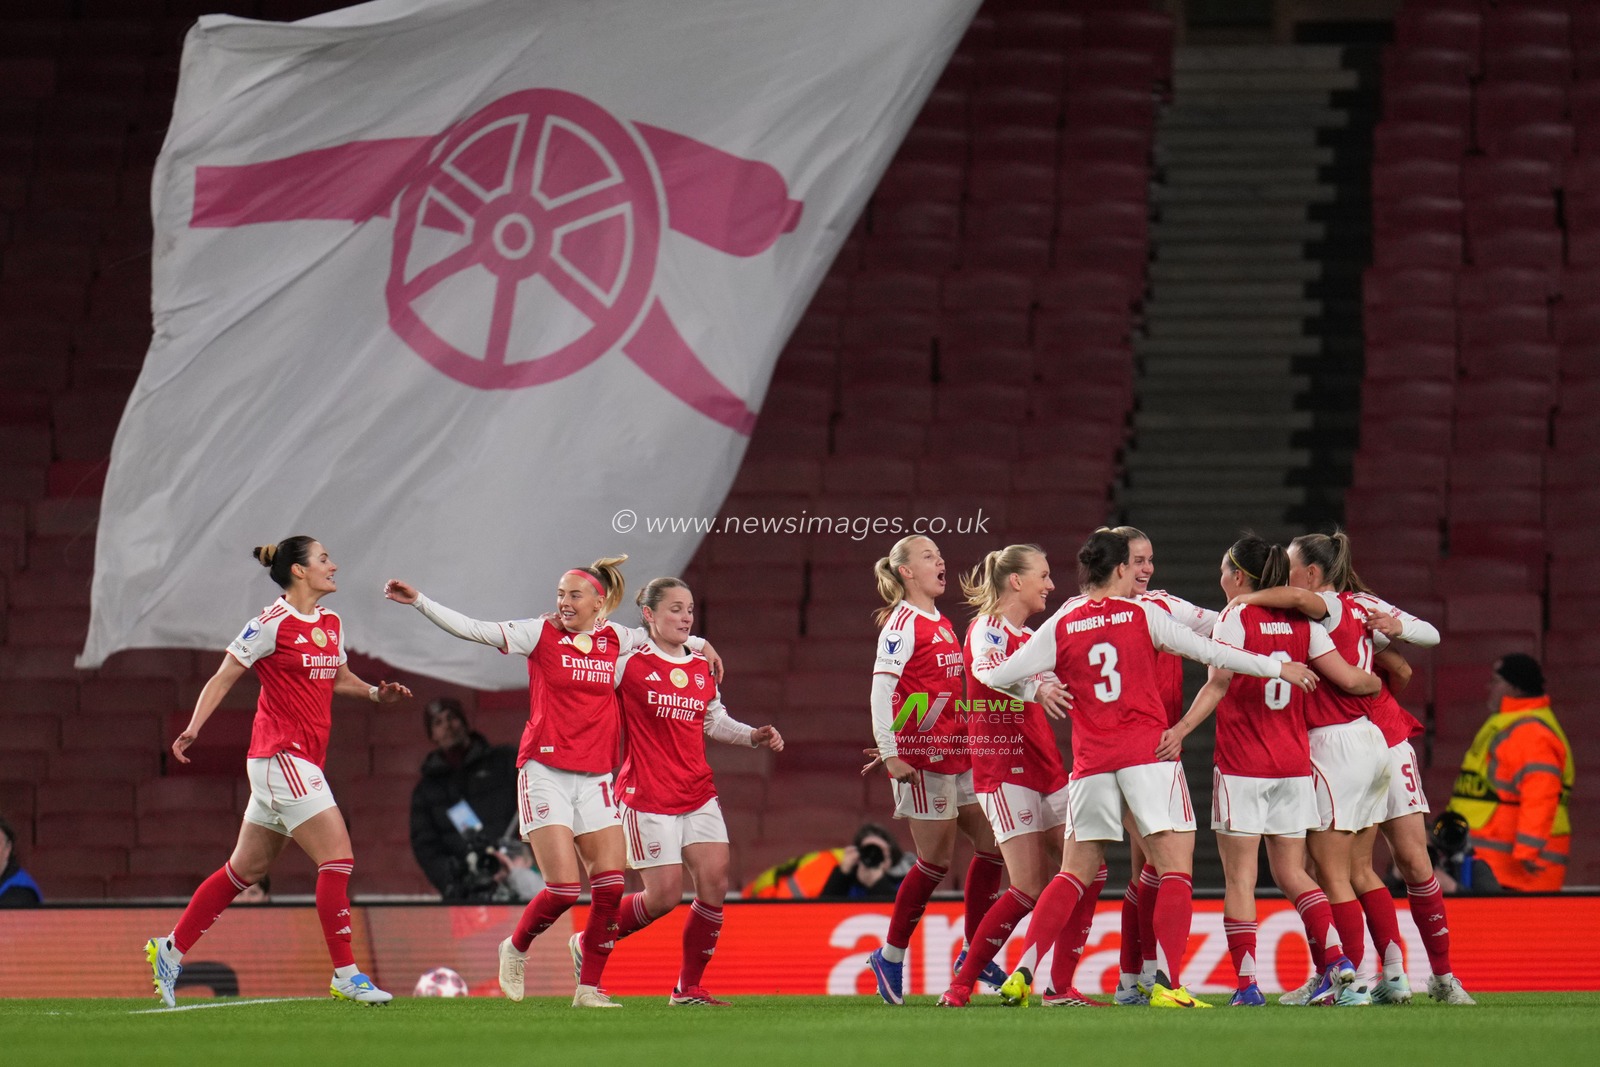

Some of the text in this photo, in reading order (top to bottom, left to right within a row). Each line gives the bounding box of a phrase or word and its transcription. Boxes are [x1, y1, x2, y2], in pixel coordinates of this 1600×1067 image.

[1066, 610, 1134, 635] WUBBEN-MOY
[301, 652, 341, 668] Emirate
[561, 654, 615, 673] Emirates
[572, 669, 611, 684] FLY BETTER
[1087, 641, 1123, 704] 3
[647, 690, 705, 712] Emirates
[655, 706, 696, 722] FLY BETTER
